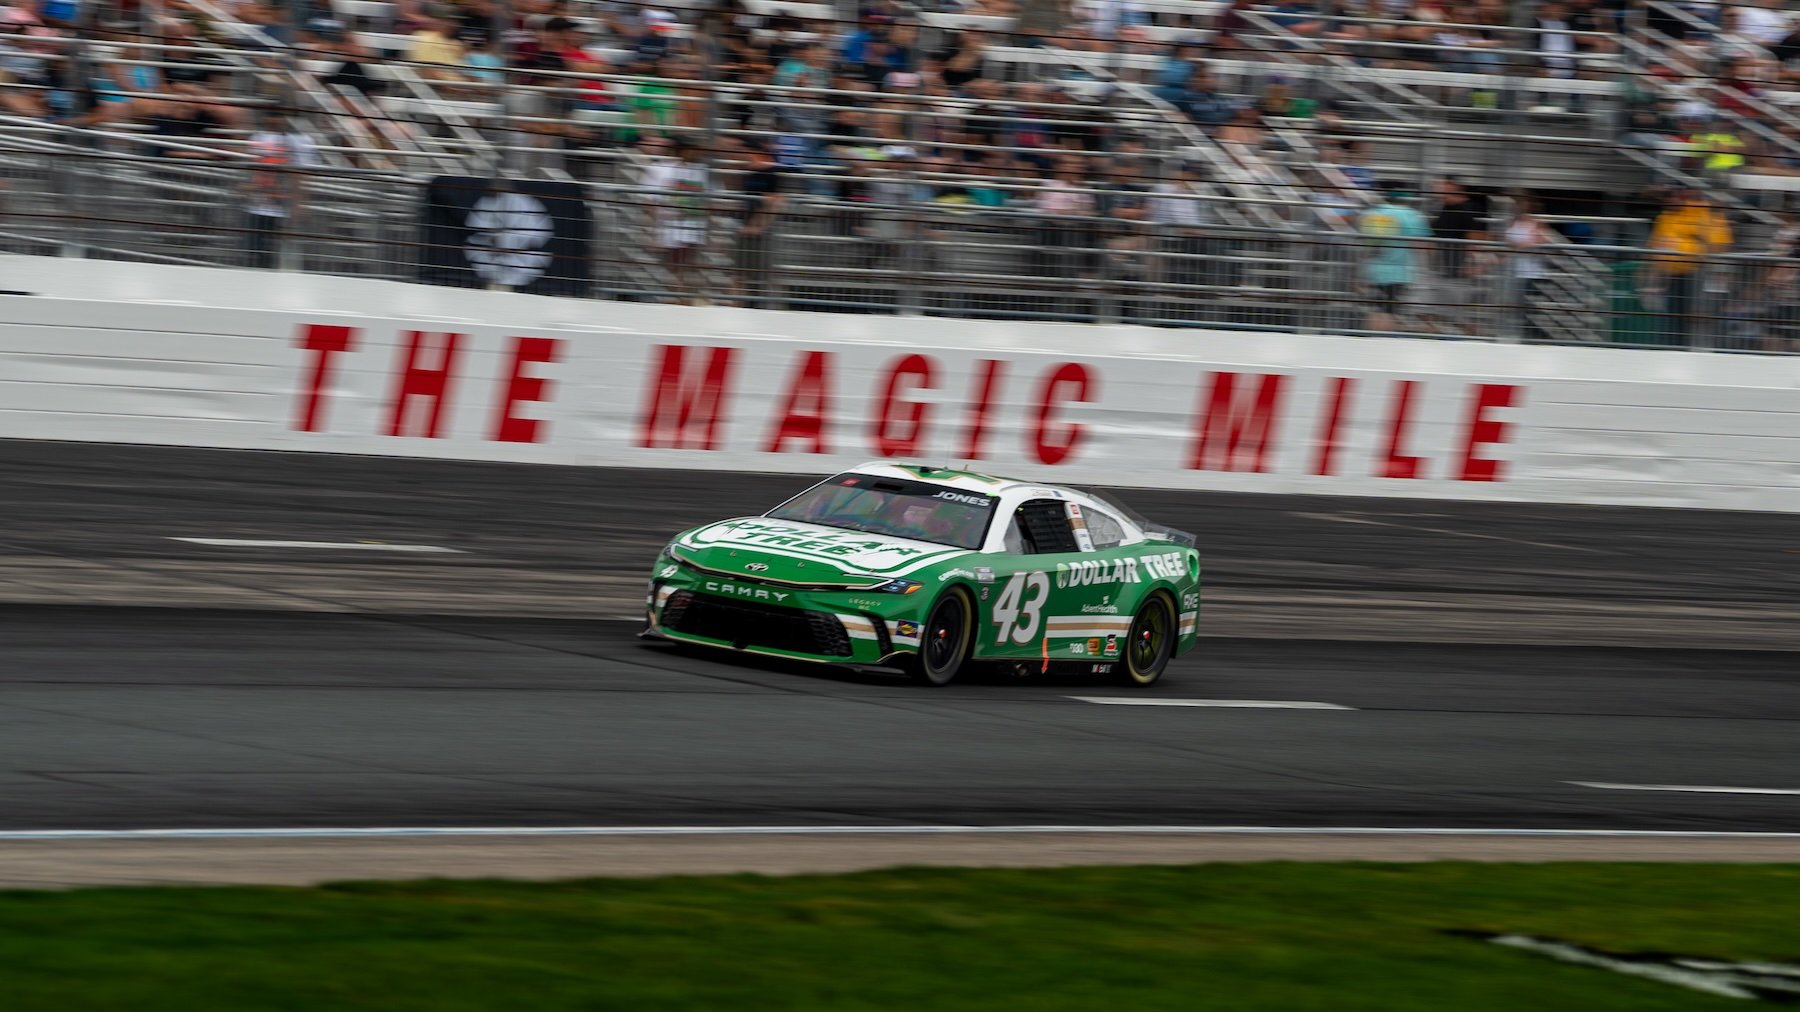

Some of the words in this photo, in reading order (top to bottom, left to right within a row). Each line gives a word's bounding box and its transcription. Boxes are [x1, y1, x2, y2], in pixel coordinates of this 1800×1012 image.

[292, 323, 567, 443] THE
[636, 344, 1100, 465] MAGIC
[1184, 371, 1527, 482] MILE
[932, 491, 991, 507] JONES
[737, 532, 862, 556] TREE
[1068, 557, 1141, 588] DOLLAR
[1140, 551, 1186, 580] TREE
[705, 581, 789, 602] CAMRY
[992, 571, 1050, 645] 43
